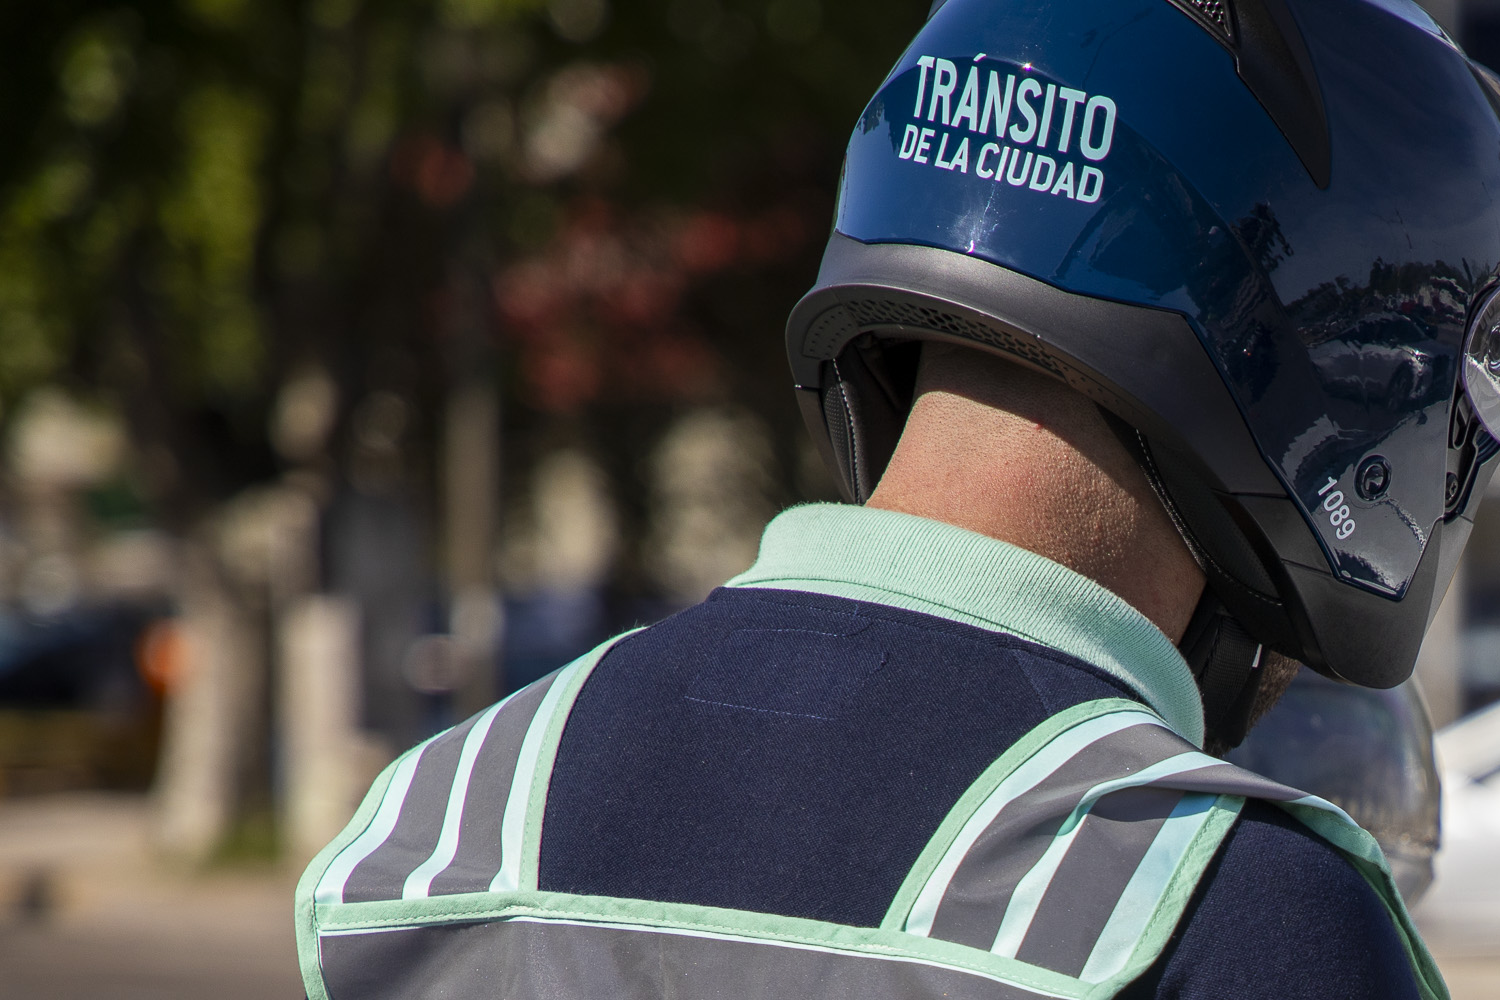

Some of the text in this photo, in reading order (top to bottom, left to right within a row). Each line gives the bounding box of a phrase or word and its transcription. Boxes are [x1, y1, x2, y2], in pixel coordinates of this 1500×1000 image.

[913, 52, 1117, 161] TRÁNSITO
[898, 123, 1104, 204] DE LA CIUDAD
[1317, 476, 1356, 540] 1089
